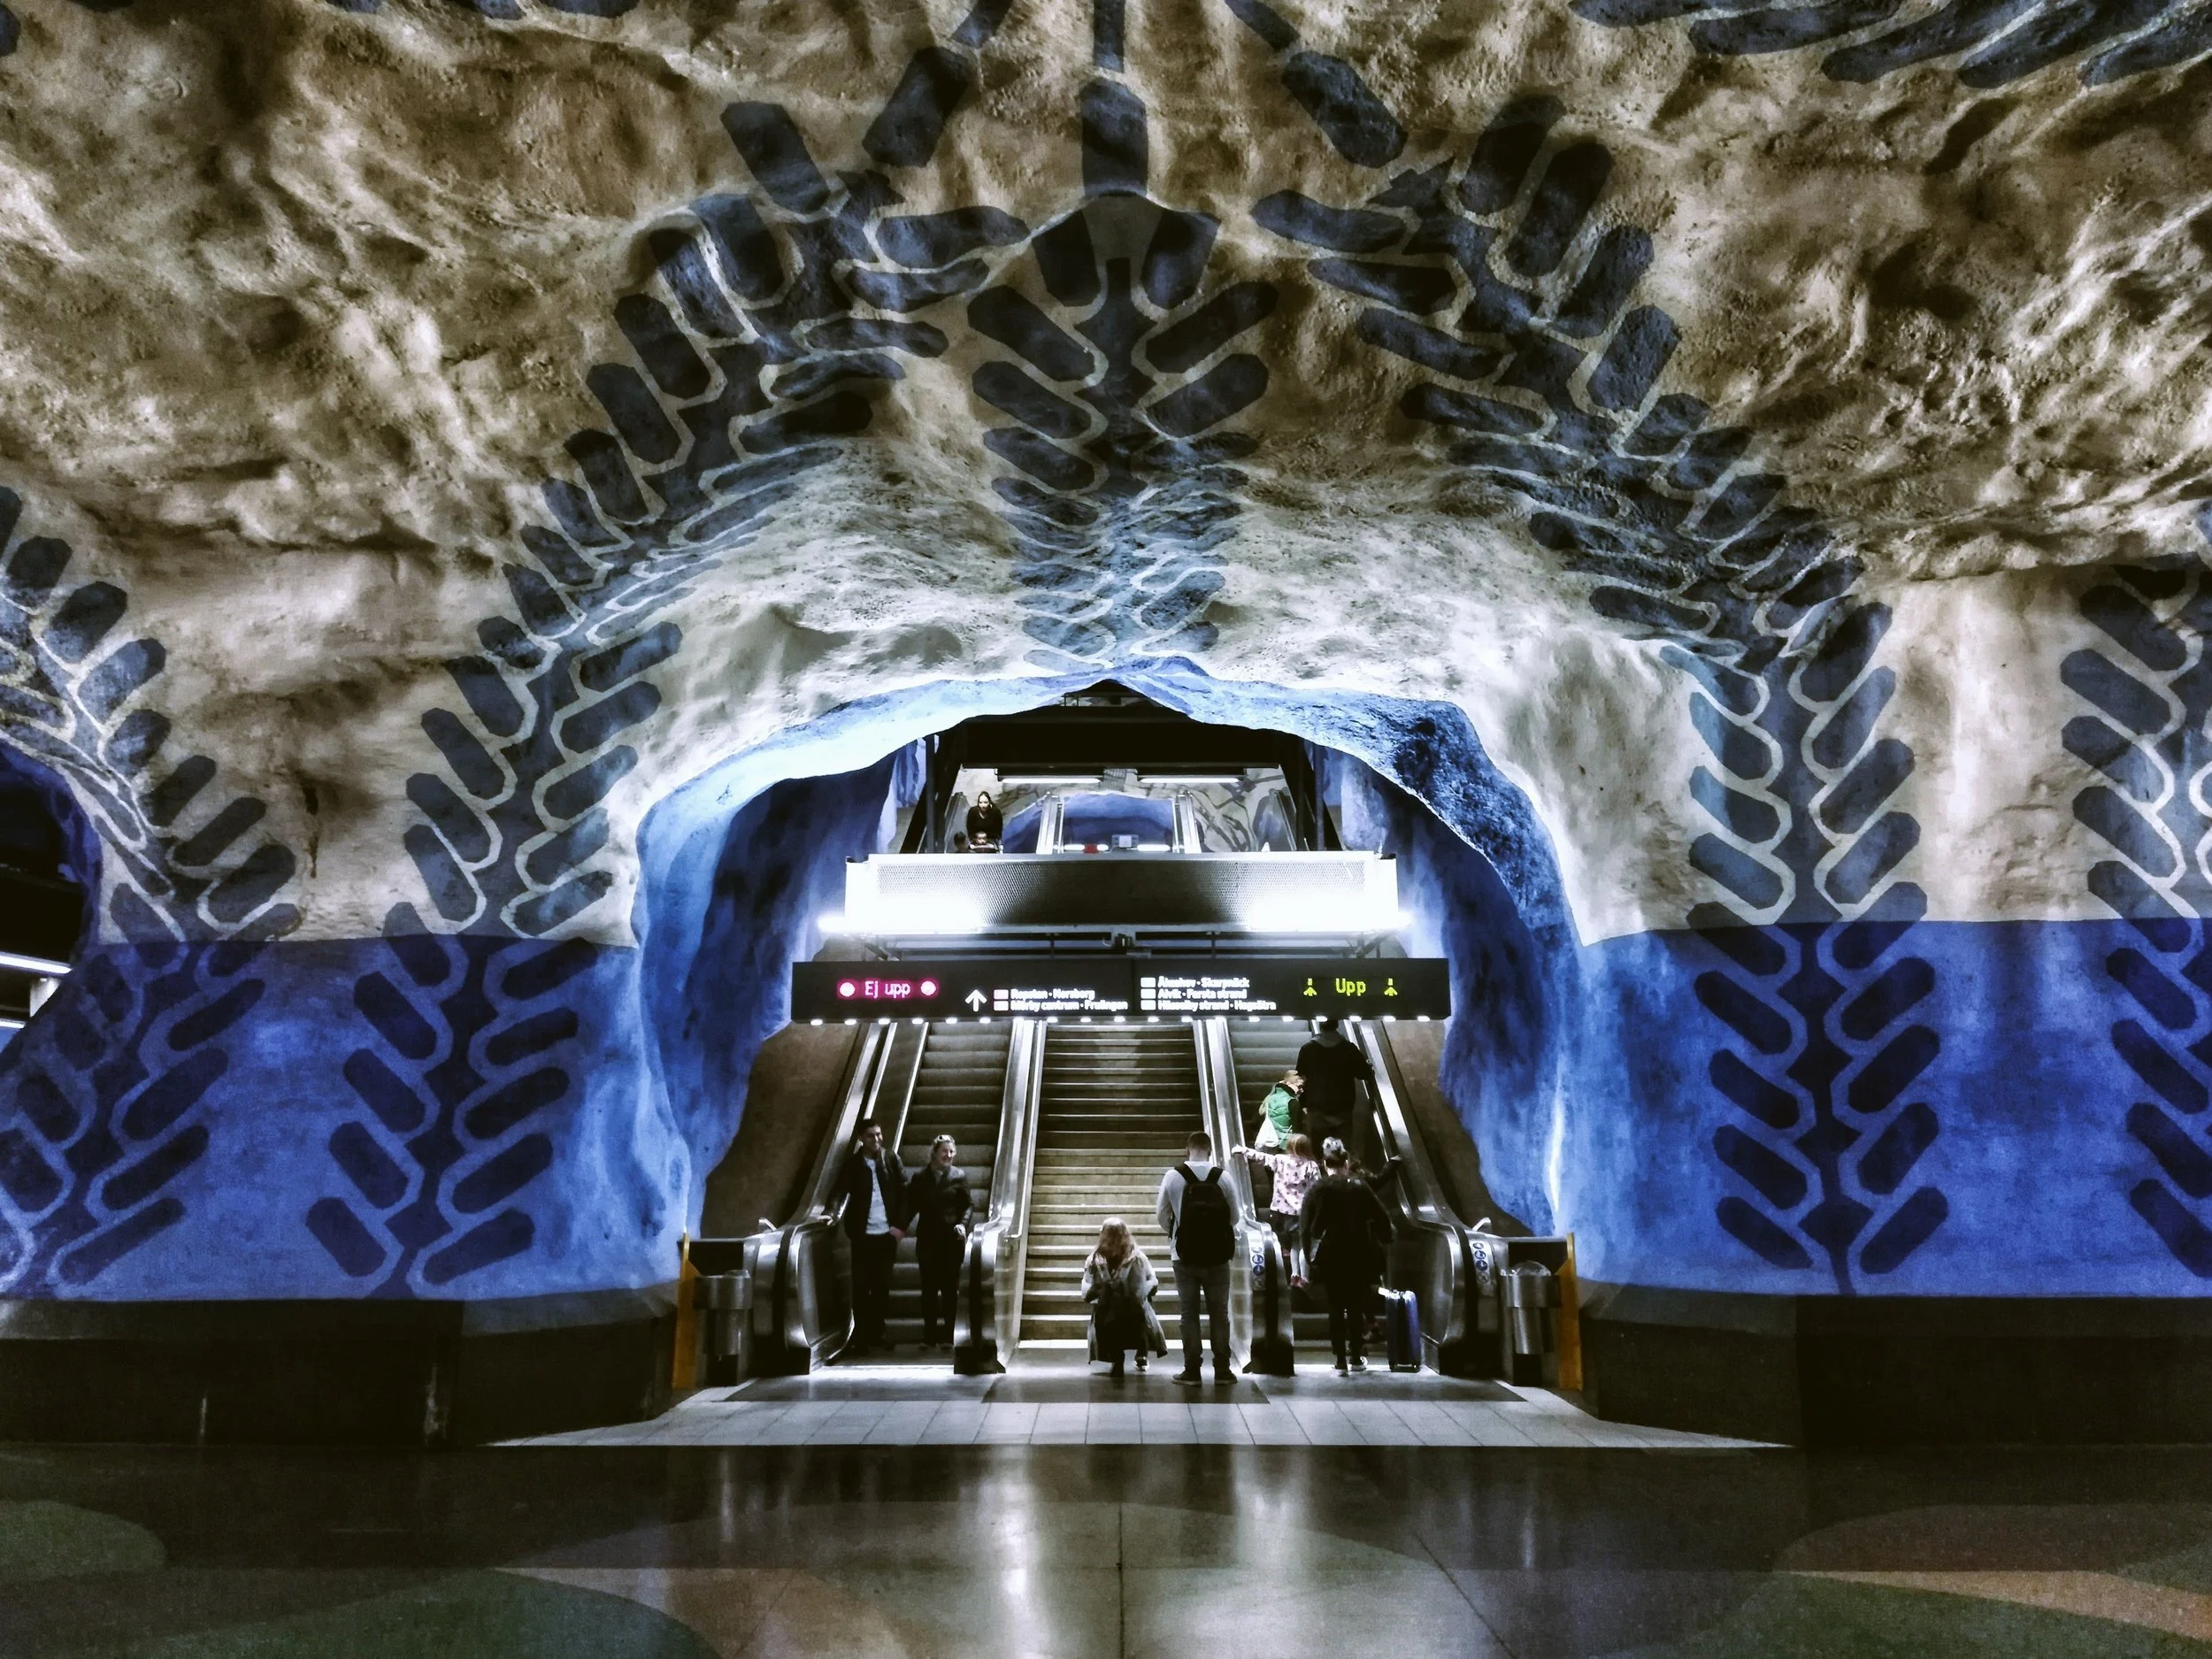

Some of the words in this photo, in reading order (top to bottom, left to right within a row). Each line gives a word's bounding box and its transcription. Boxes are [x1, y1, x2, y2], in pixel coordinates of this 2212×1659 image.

[864, 980, 879, 999] Ej
[885, 983, 911, 999] upp
[1335, 978, 1366, 997] Upp
